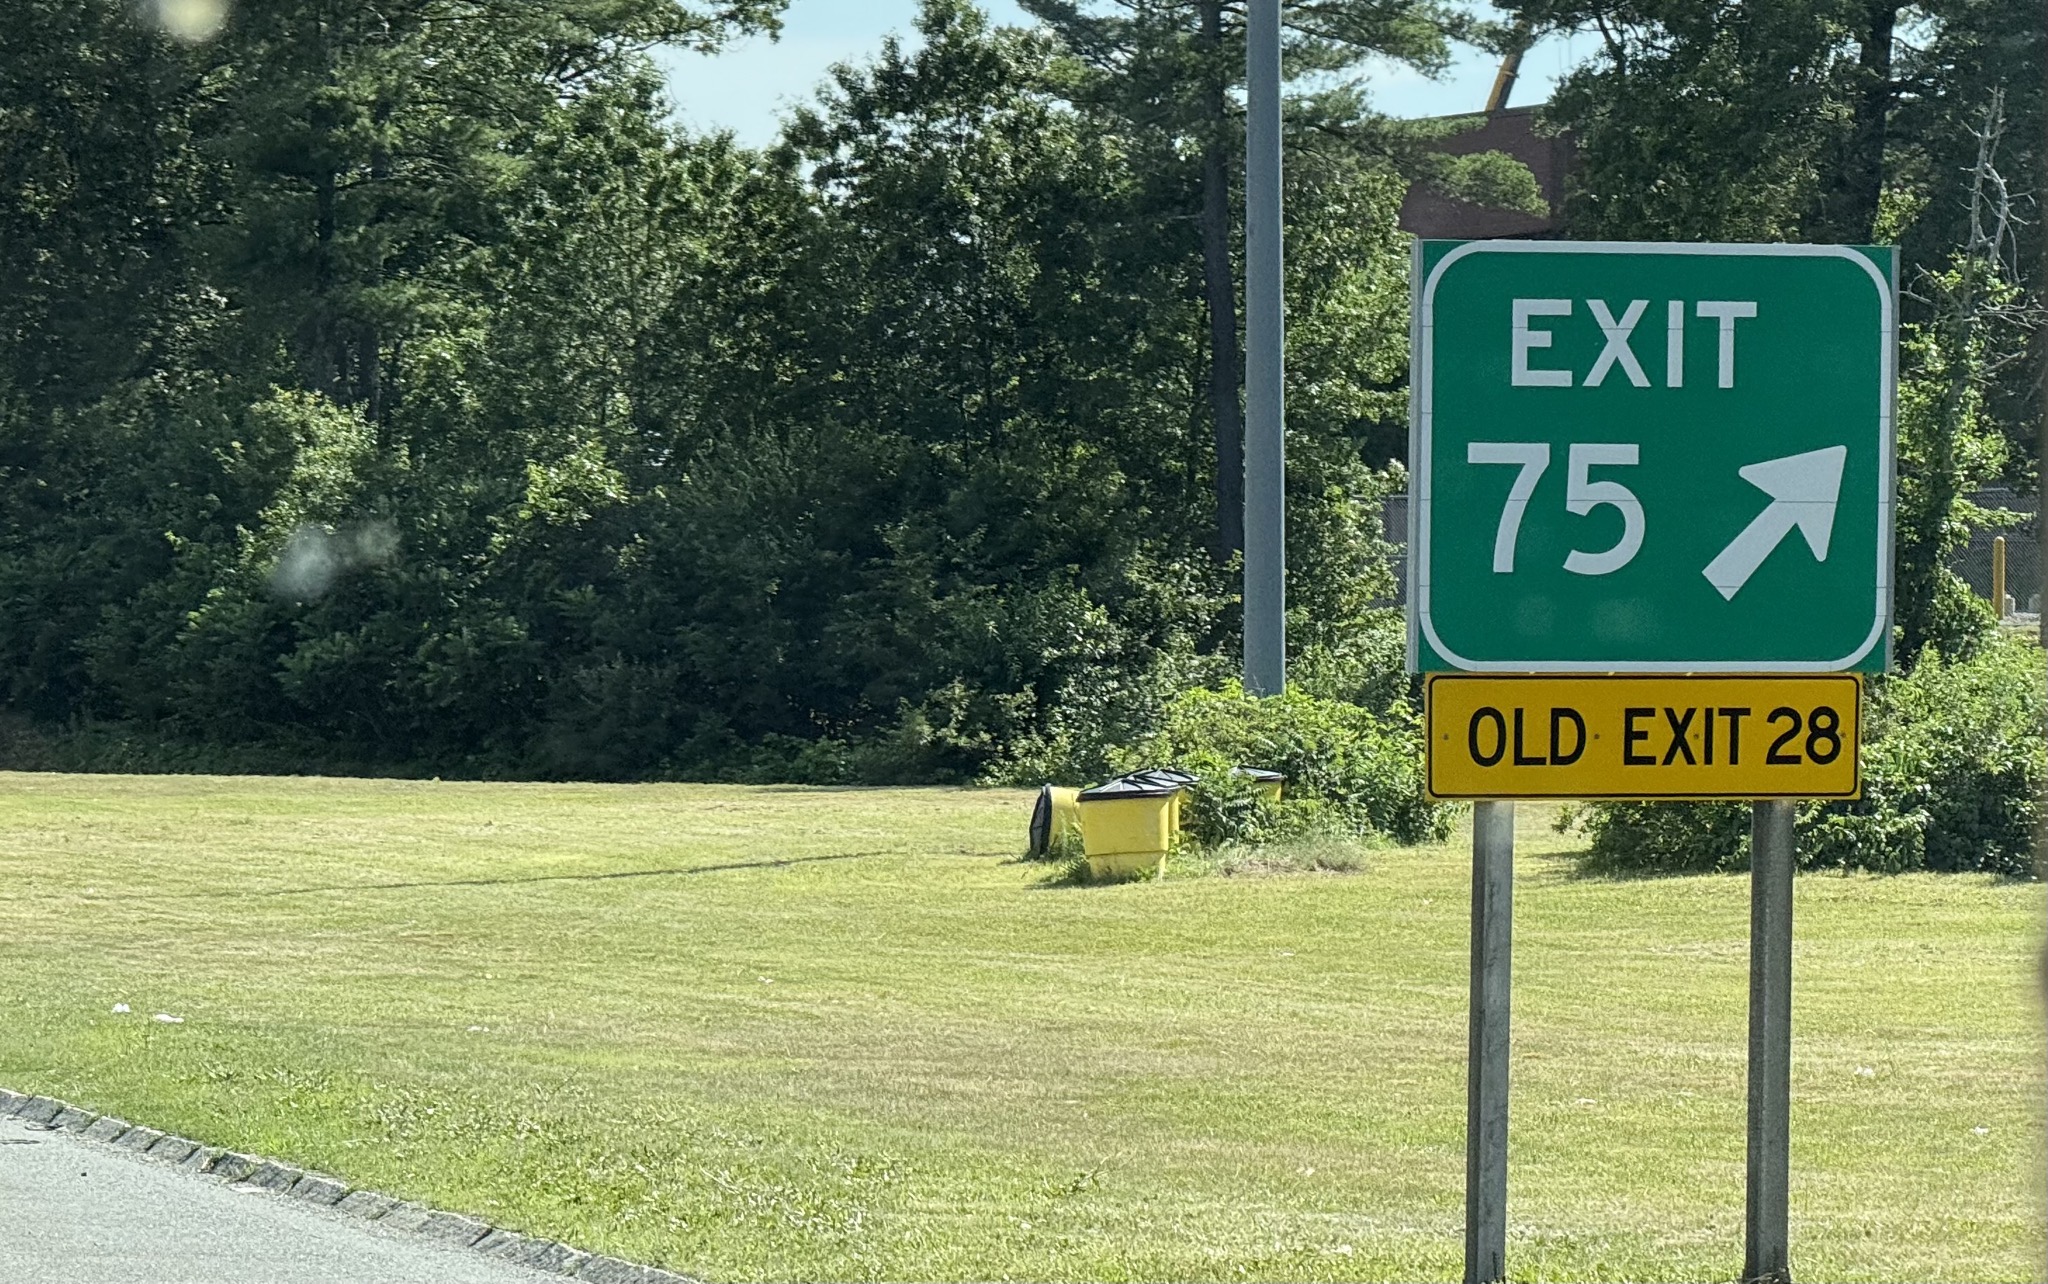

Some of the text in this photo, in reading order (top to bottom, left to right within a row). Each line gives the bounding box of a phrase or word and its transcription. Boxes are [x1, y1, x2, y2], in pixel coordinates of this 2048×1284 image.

[1511, 298, 1757, 388] EXIT
[1467, 442, 1646, 575] 75
[1468, 706, 1841, 767] OLD EXIT 28
